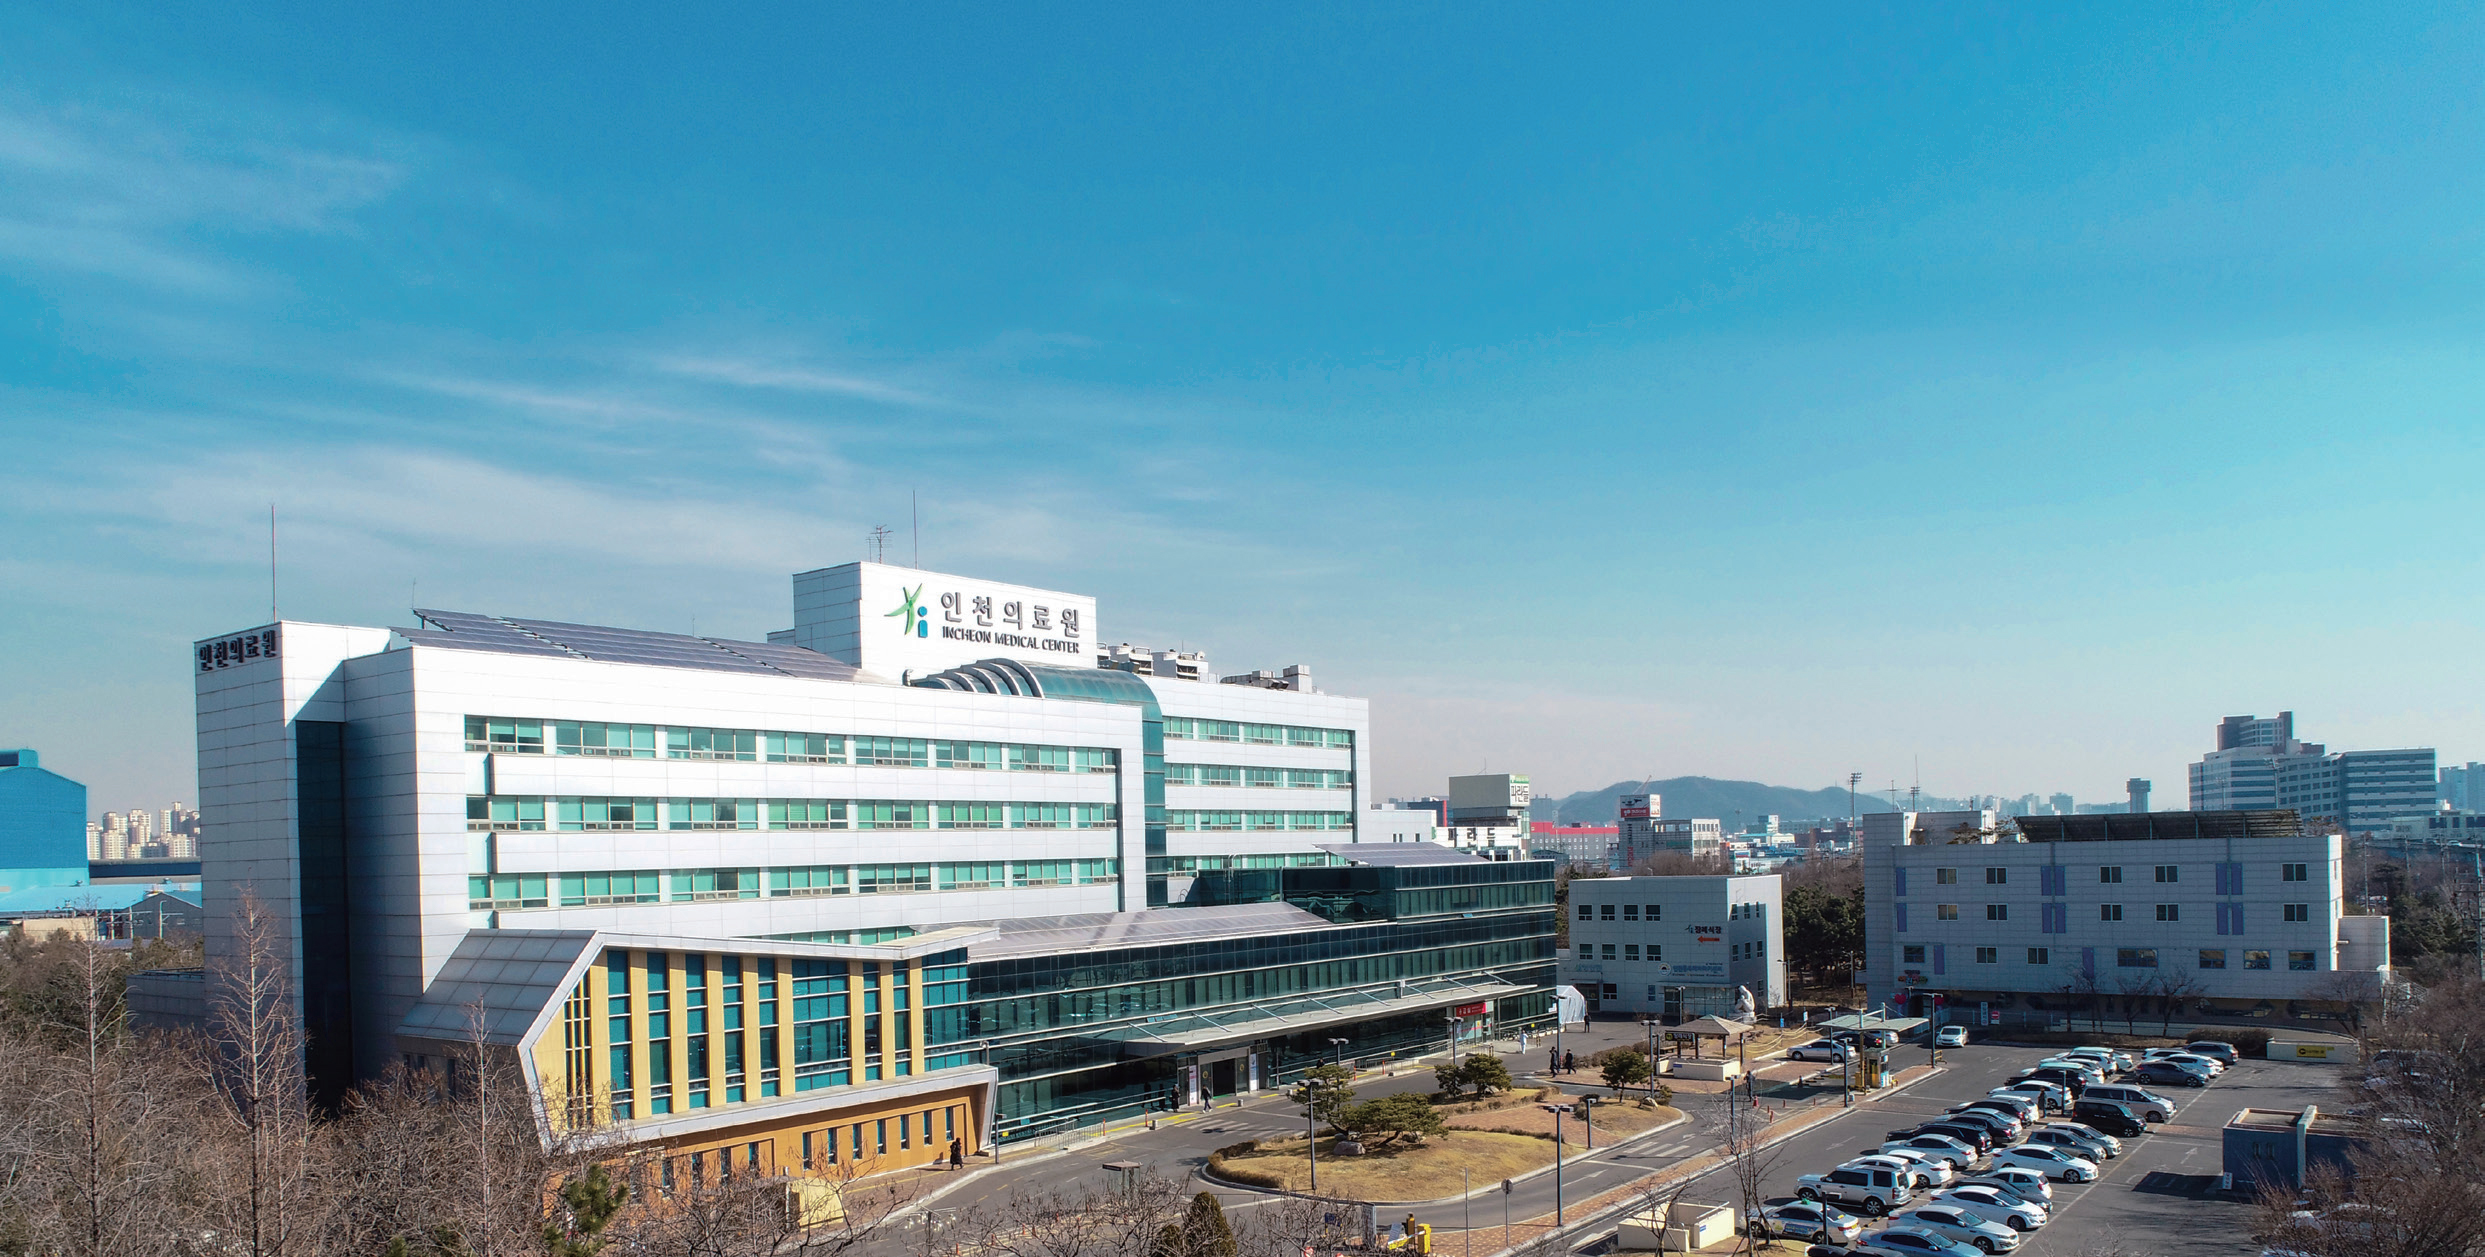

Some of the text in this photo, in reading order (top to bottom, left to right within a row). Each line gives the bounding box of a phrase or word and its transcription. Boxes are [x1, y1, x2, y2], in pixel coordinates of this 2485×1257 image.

[941, 592, 1080, 638] 인천의료원
[199, 629, 277, 671] 인천의료원
[942, 625, 1080, 654] INCHEON MEDICAL CENTER
